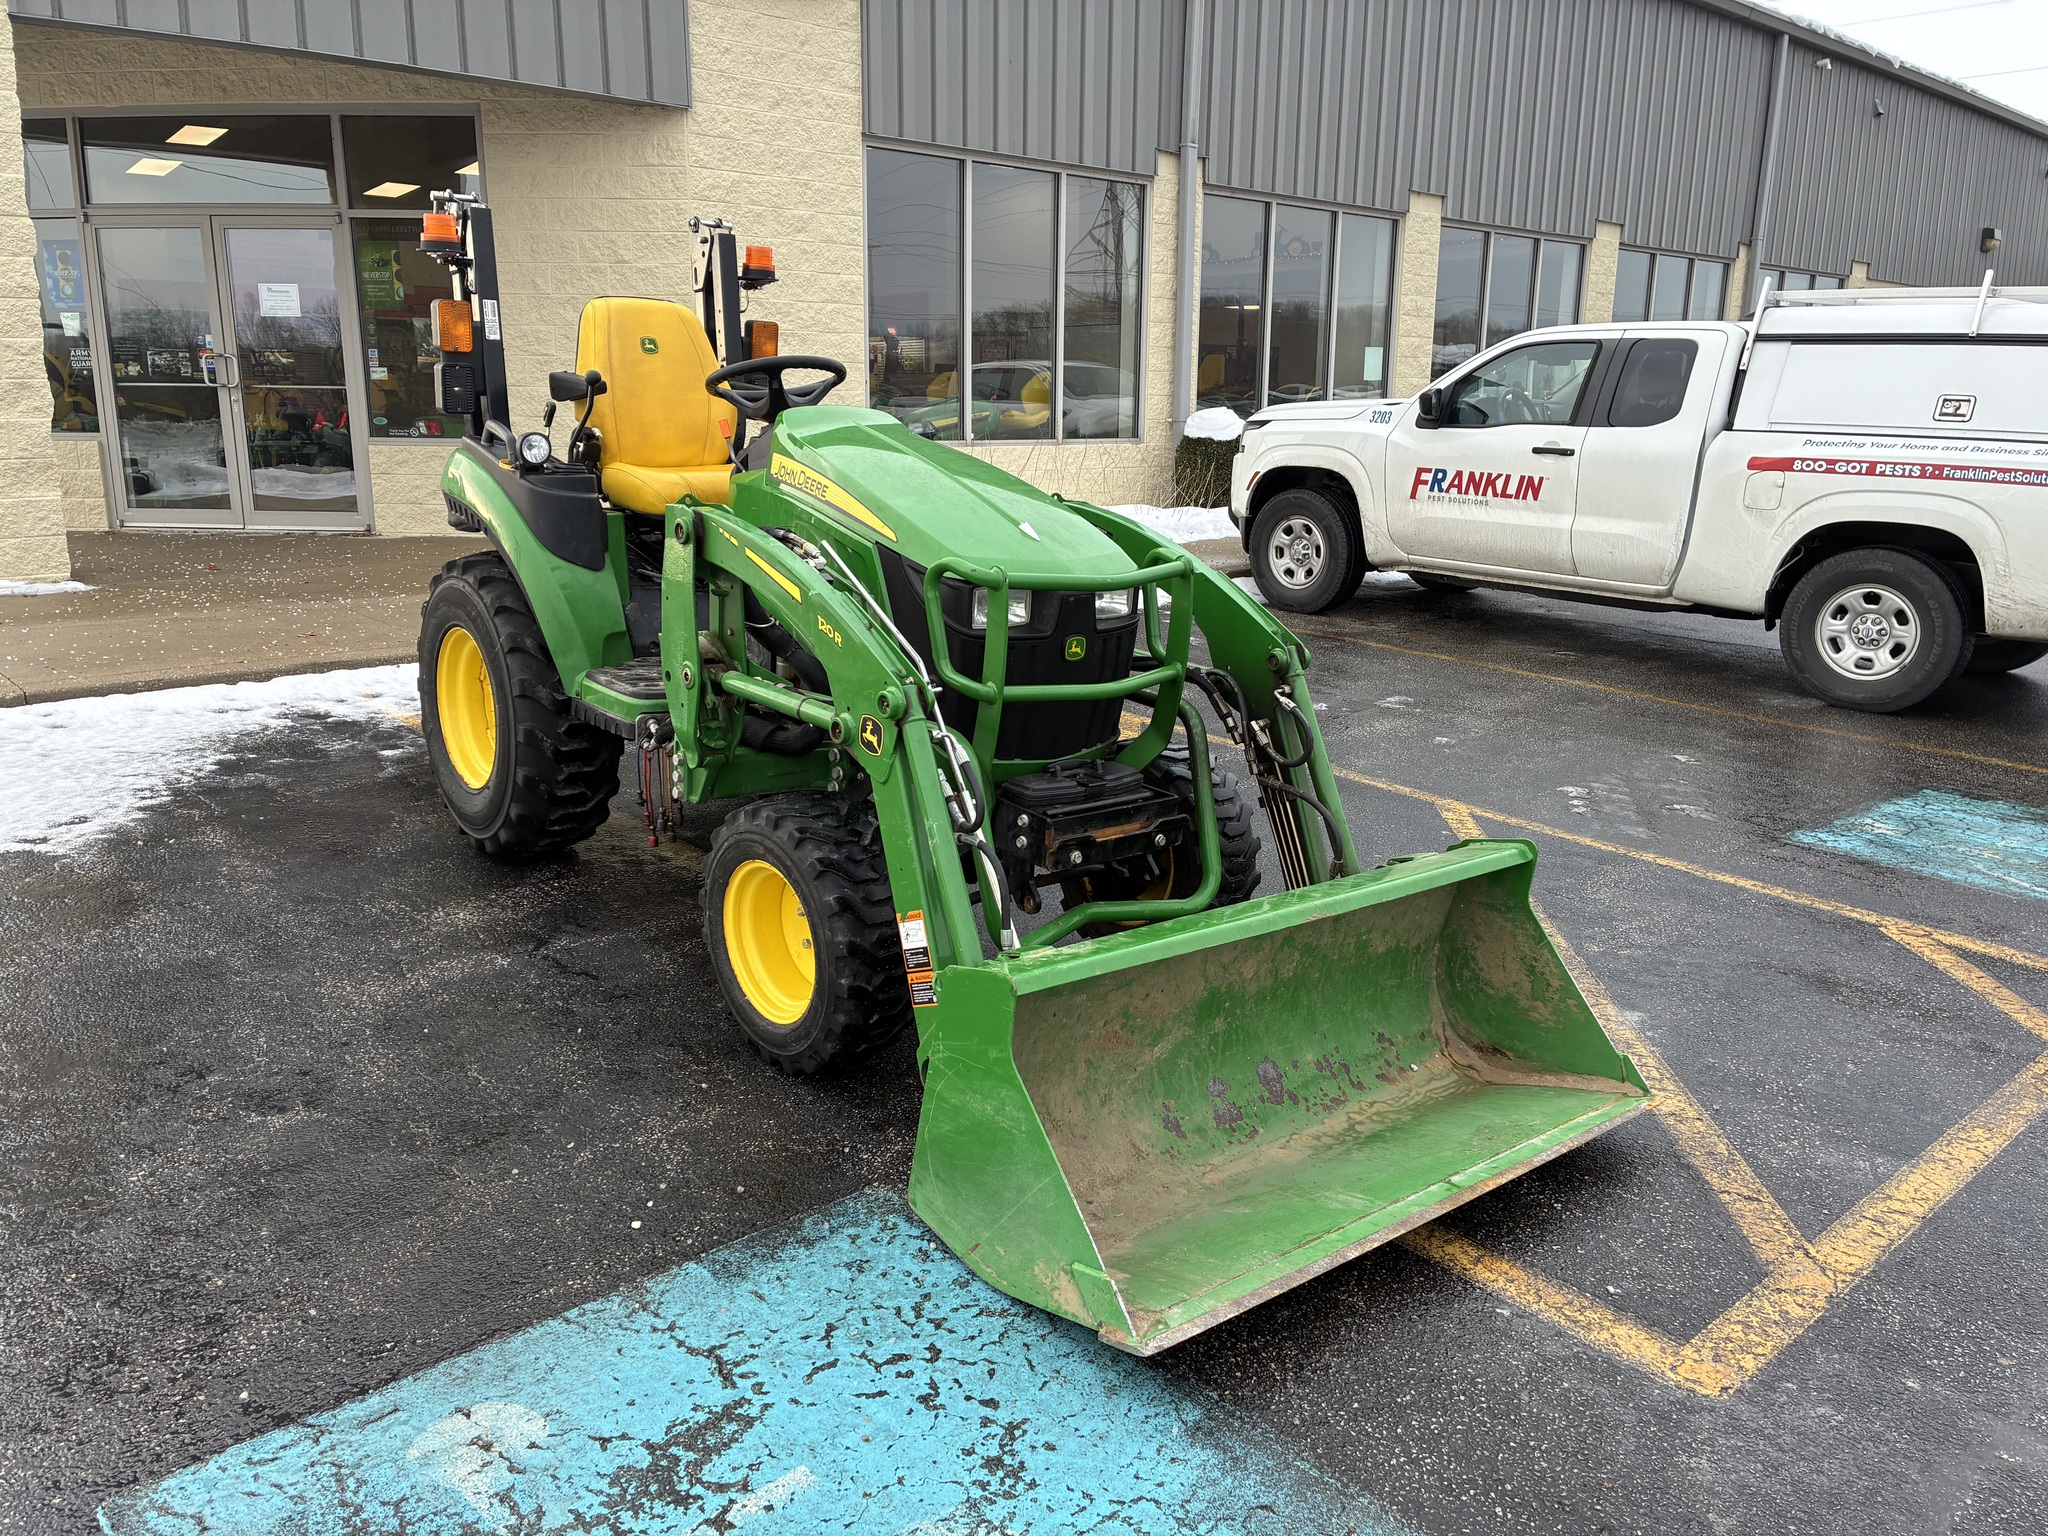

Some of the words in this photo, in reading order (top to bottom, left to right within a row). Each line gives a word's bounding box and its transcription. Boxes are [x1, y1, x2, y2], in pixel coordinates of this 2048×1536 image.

[391, 225, 420, 233] LIFESTYL
[362, 271, 391, 279] NEVERSTOP
[1369, 410, 1393, 425] 3203
[1802, 439, 1866, 449] Protecting
[1870, 441, 1899, 450] Your
[1899, 442, 1939, 451] Home
[1941, 444, 1969, 452] and
[1970, 446, 2030, 456] Business
[1792, 460, 1870, 474] 800-GOT
[1875, 463, 1921, 477] PESTS
[774, 461, 798, 486] JOHN
[797, 470, 829, 499] DEERE
[1409, 467, 1544, 501] FRANKLIN
[1448, 496, 1489, 507] SOLUTIONS
